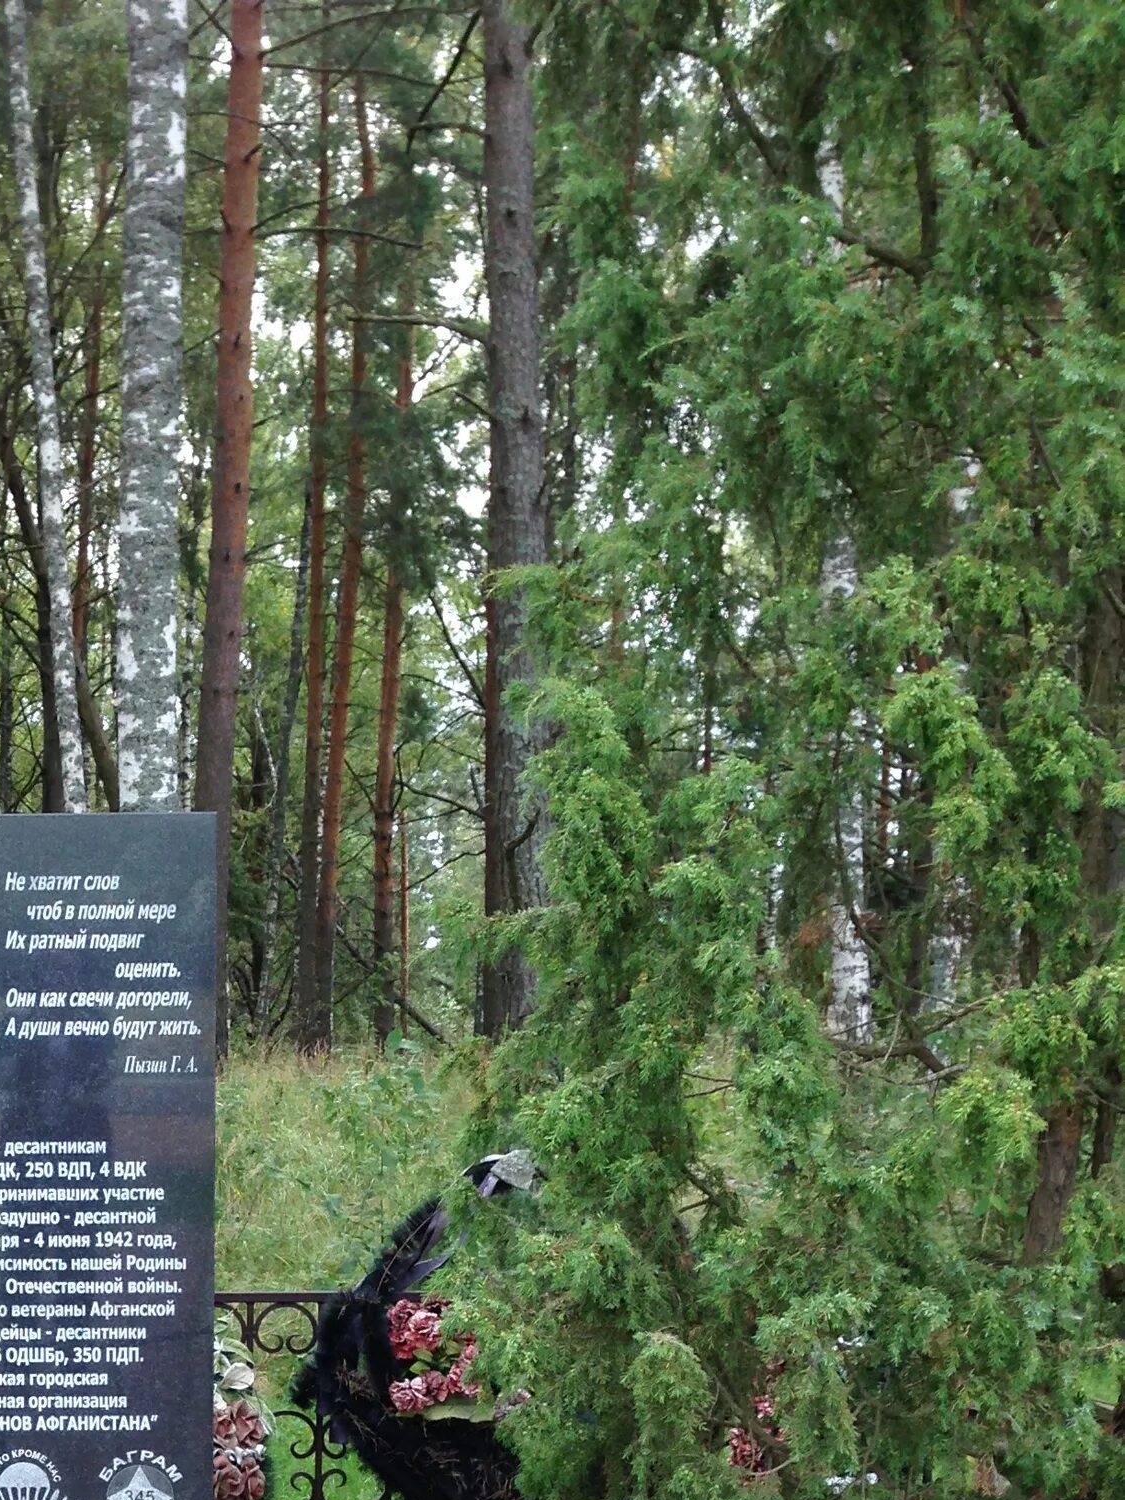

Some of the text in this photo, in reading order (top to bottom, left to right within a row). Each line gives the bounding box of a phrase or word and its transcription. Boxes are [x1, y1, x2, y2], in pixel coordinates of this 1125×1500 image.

[4, 871, 120, 892] Не хватит слов
[26, 898, 177, 924] чтоб в полной мере
[5, 928, 145, 954] Их ратный подвиг
[114, 962, 181, 981] оценить.
[5, 987, 193, 1011] Они как свечи догорели,
[4, 1015, 202, 1041] А души вечно будут жить.
[123, 1055, 198, 1074] Пызин Г. А.
[3, 1140, 107, 1157] десантникам
[25, 1161, 54, 1178] 250
[57, 1161, 96, 1181] ВДП,
[99, 1161, 111, 1178] 4
[113, 1160, 147, 1181] ВДК
[102, 1187, 165, 1205] участие
[73, 1206, 156, 1227] десантной
[33, 1231, 45, 1248] 4
[48, 1234, 91, 1248] июня
[95, 1230, 134, 1248] 1942
[137, 1234, 177, 1250] года,
[71, 1253, 122, 1271] нашей
[126, 1254, 187, 1273] Родины
[5, 1276, 124, 1295] Отечественной
[127, 1276, 183, 1294] войны.
[11, 1304, 86, 1321] ветераны
[89, 1299, 176, 1320] Афганской
[55, 1327, 147, 1343] десантники
[5, 1346, 69, 1367] ОДШБр,
[72, 1346, 102, 1363] 350
[105, 1346, 144, 1366] ПДП.
[29, 1372, 109, 1390] городская
[28, 1395, 128, 1413] организация
[11, 1449, 46, 1464] КРОМЕ
[45, 1459, 63, 1483] НАС
[97, 1449, 184, 1483] БАГРАМ
